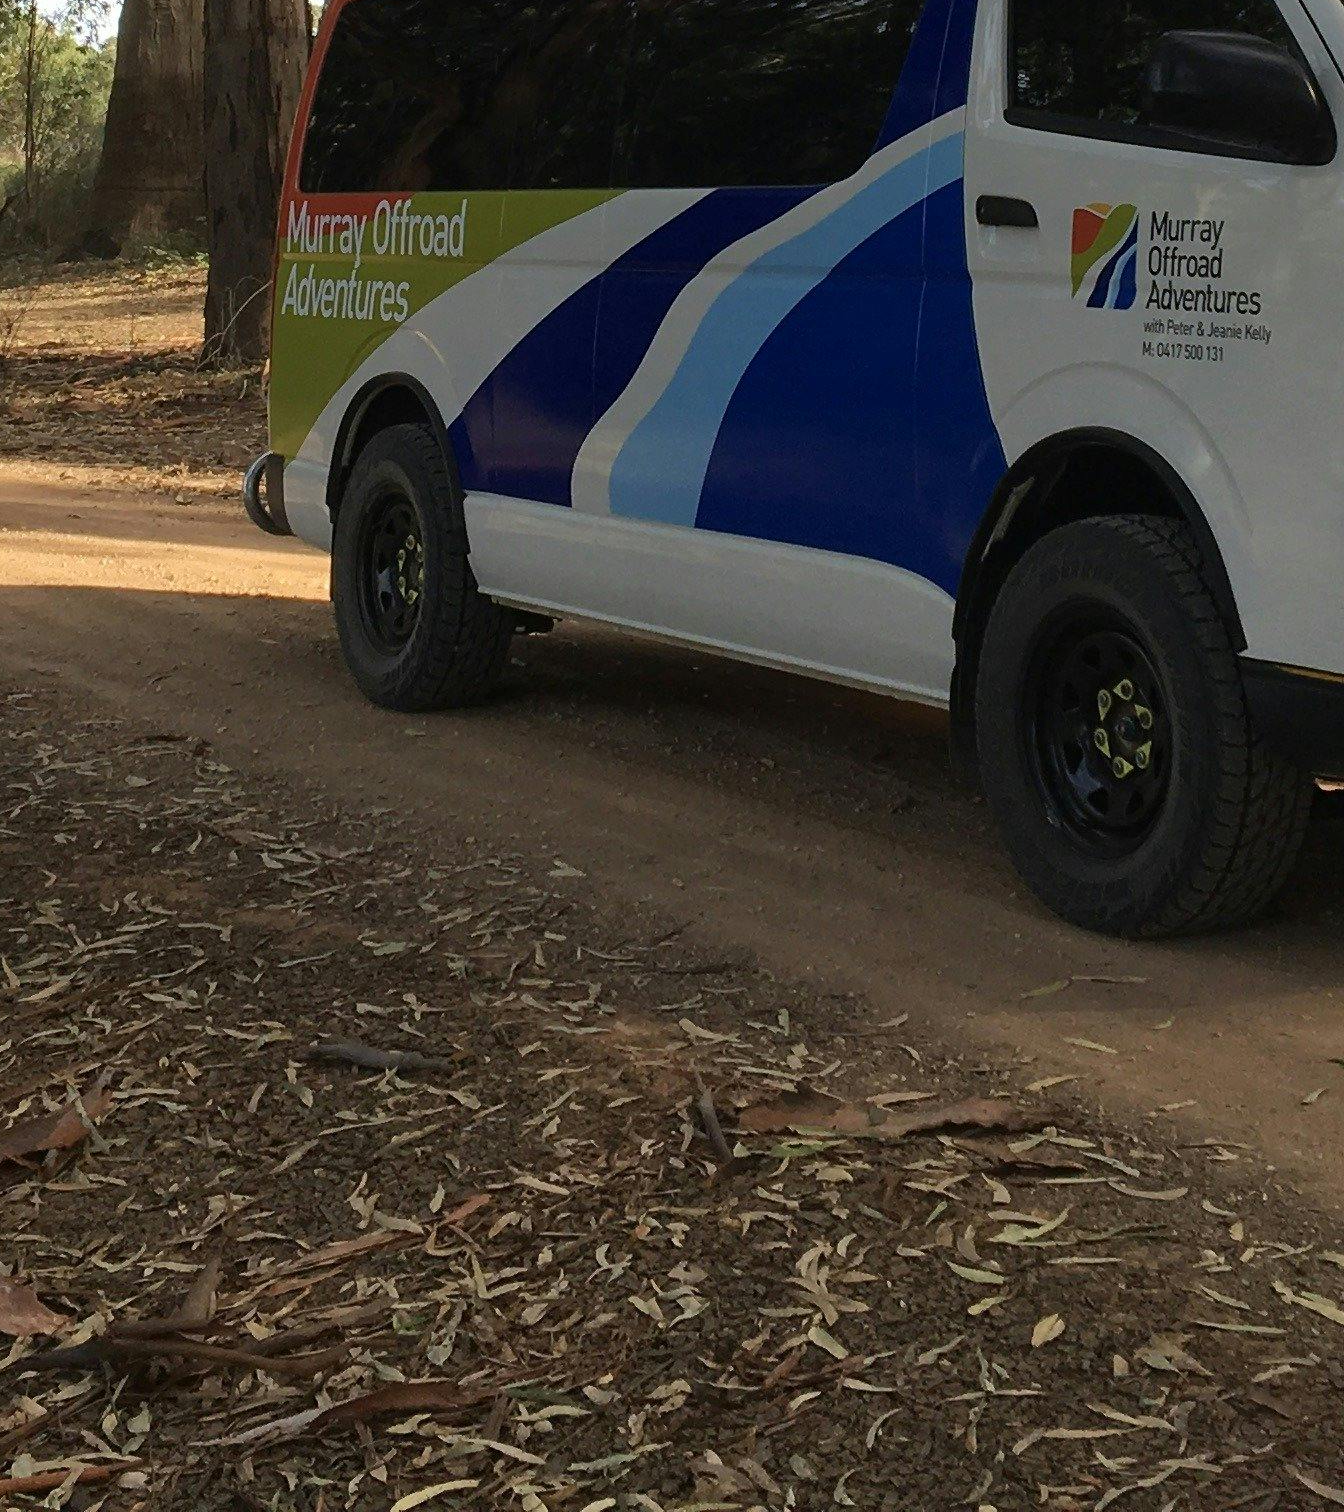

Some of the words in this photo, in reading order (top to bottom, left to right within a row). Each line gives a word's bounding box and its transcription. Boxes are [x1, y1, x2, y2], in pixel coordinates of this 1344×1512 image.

[286, 200, 367, 268] Murray
[373, 198, 468, 257] Offroad
[1150, 211, 1225, 250] Murray
[1148, 246, 1223, 278] Offroad
[281, 263, 410, 322] Adventures
[1145, 280, 1262, 315] Adventures
[1143, 318, 1165, 334] with
[1167, 319, 1194, 336] Peter
[1196, 321, 1205, 337] &
[1245, 324, 1271, 345] Kelly
[1157, 342, 1182, 359] 0417
[1206, 346, 1224, 362] 131
